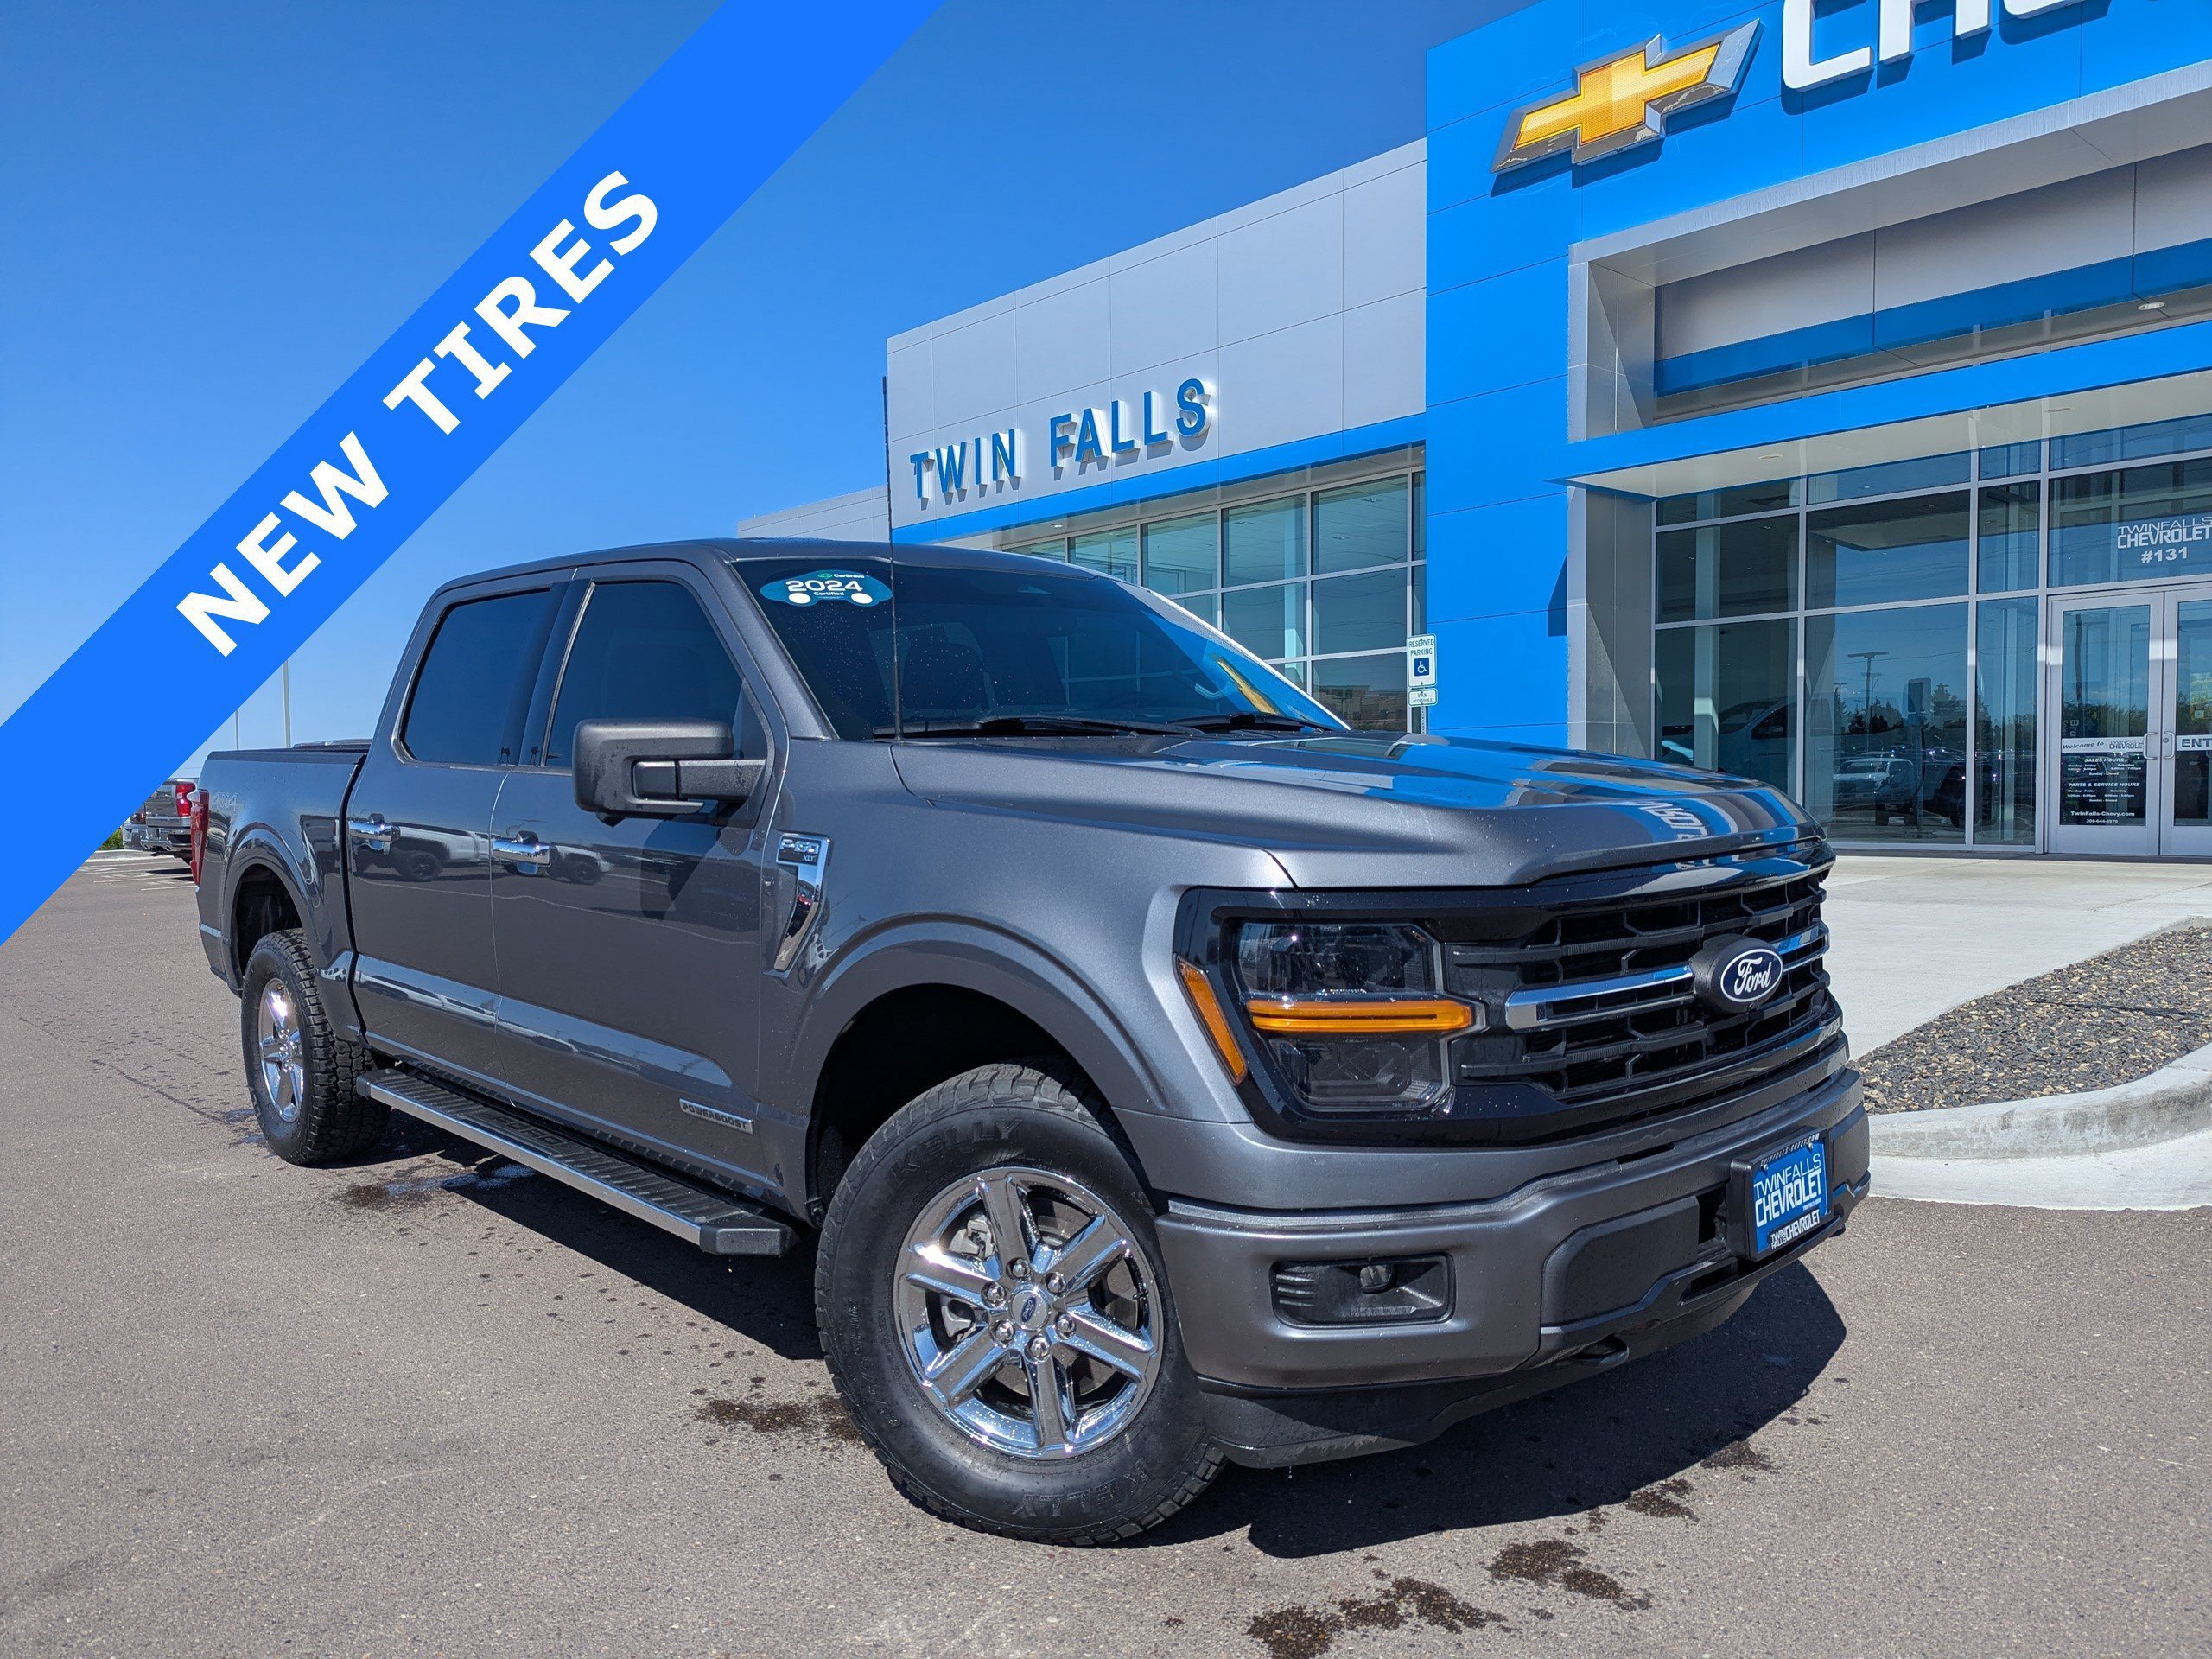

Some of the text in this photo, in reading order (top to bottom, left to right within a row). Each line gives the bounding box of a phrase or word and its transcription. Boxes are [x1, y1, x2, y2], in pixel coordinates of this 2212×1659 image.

[909, 378, 1210, 500] TWIN FALLS
[2117, 516, 2212, 535] TWINFALLS
[2117, 525, 2212, 549] CHEVROLET
[2141, 546, 2188, 563] #131
[785, 580, 863, 592] 2024
[1408, 639, 1434, 647] RESERVED
[1410, 648, 1433, 657] PARKING
[2063, 741, 2094, 750] Welcome
[1733, 956, 1772, 995] Ford
[682, 1103, 747, 1130] POWERBOOST
[1753, 1153, 1821, 1199] TWINFALLS
[1754, 1168, 1821, 1228] CHEVROLET
[1785, 1209, 1820, 1241] CHEVROLET
[1771, 1236, 1787, 1250] FALLS
